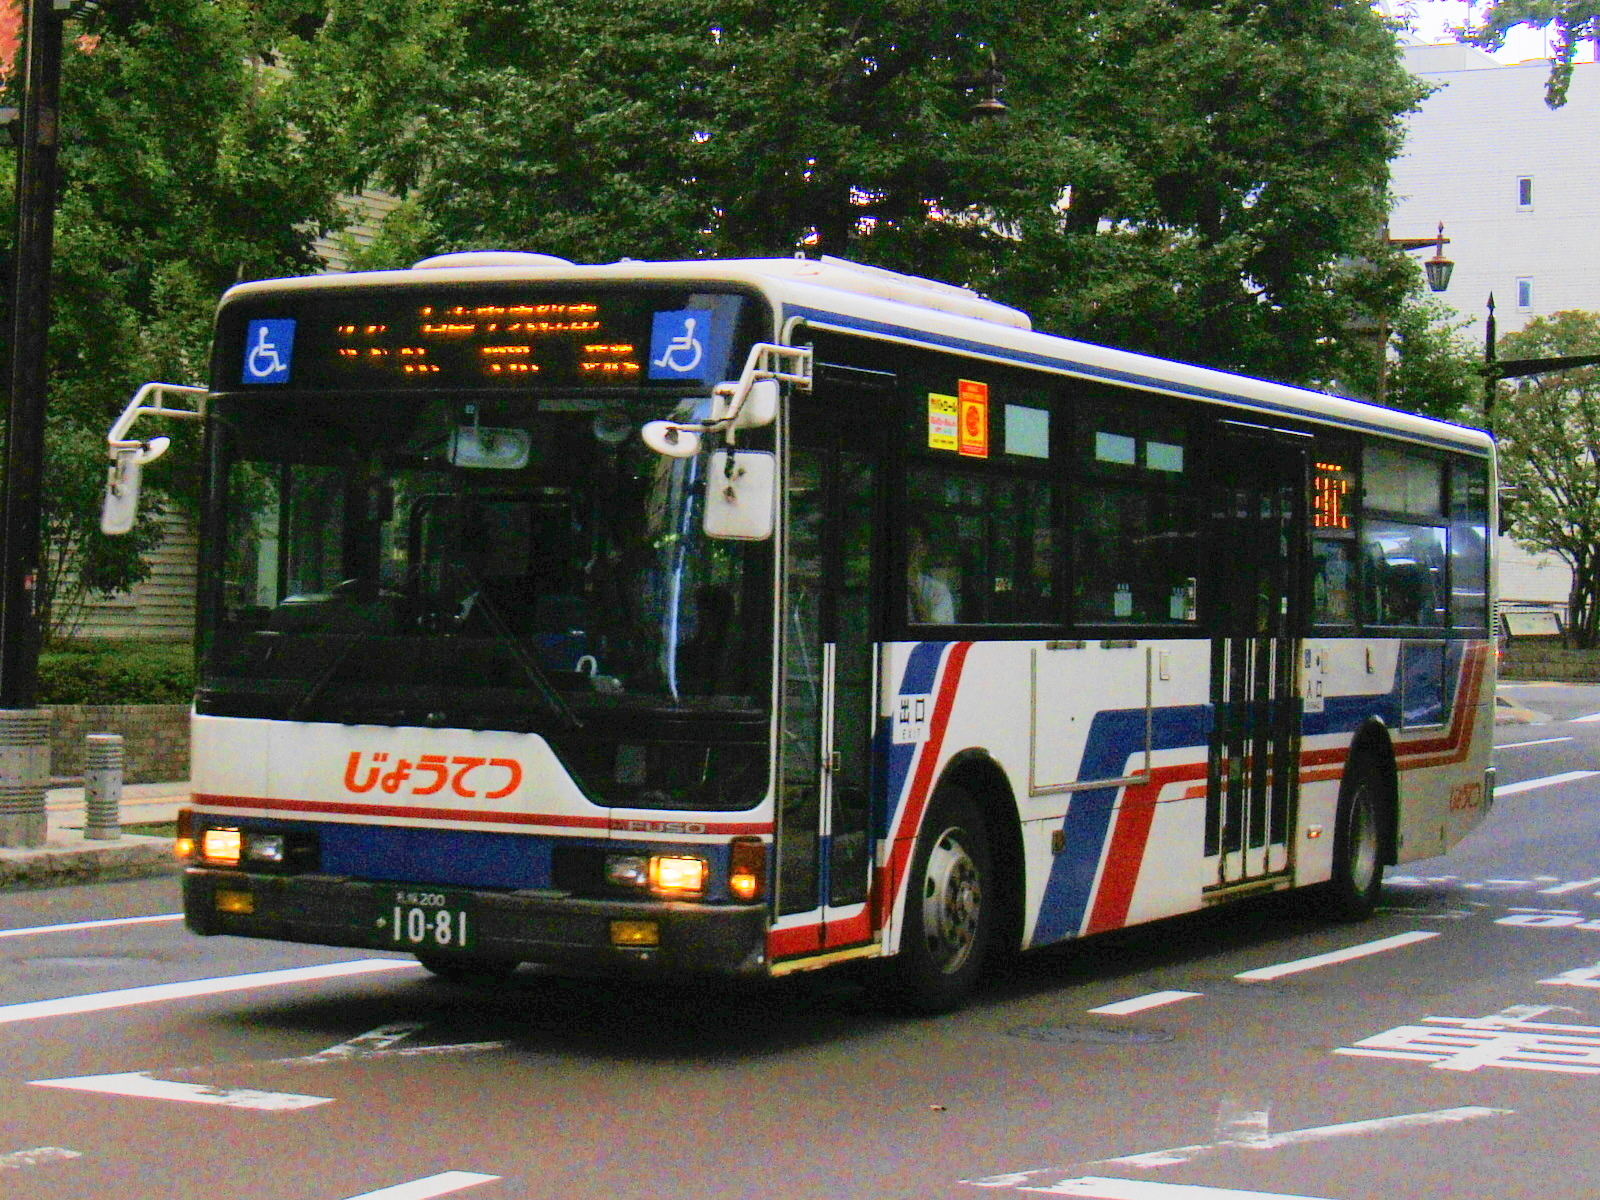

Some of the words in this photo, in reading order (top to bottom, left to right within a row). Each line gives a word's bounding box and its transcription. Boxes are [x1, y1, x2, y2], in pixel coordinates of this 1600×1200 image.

[899, 698, 925, 724] 出口
[344, 751, 523, 799] じょうてつ
[627, 820, 706, 835] FUSO
[394, 906, 467, 947] 10-81
